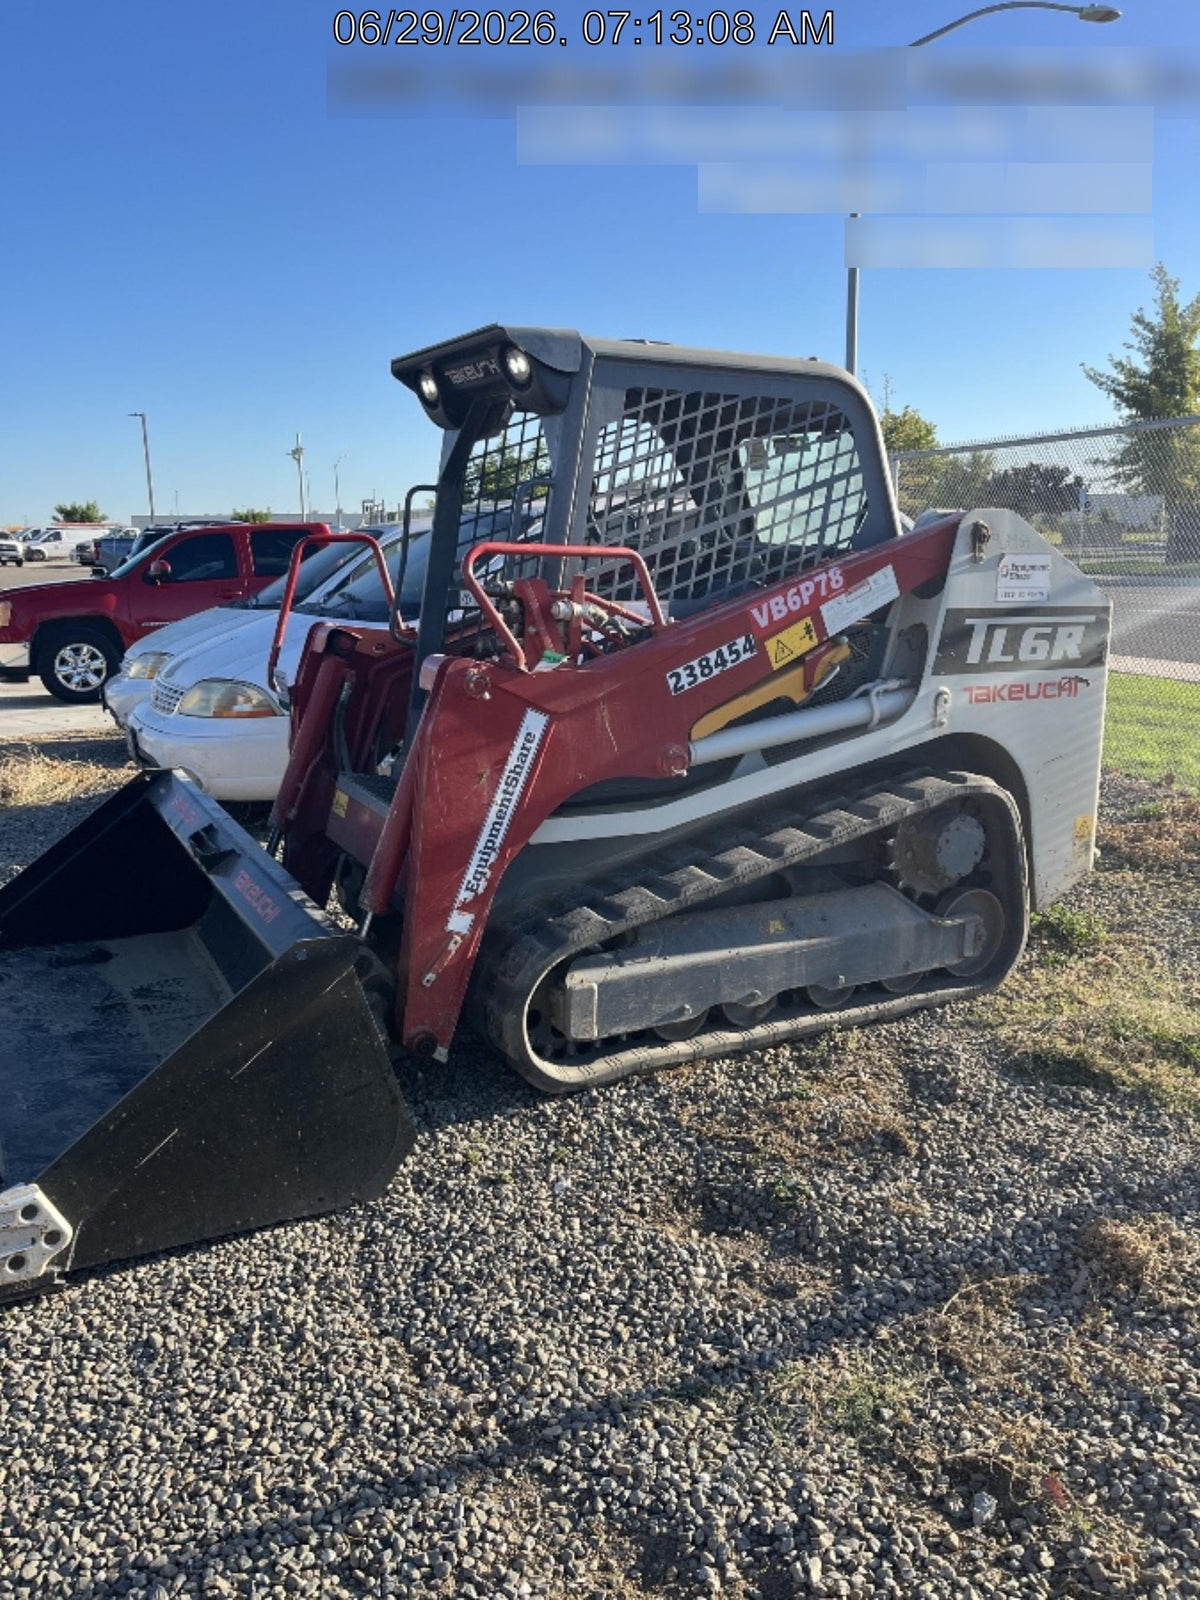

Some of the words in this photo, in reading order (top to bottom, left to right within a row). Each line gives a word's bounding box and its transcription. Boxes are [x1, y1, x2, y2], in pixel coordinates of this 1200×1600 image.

[751, 567, 843, 629] VB6P78
[669, 634, 758, 694] 238454
[965, 615, 1096, 664] TL6R
[466, 732, 535, 895] EquipmentShare
